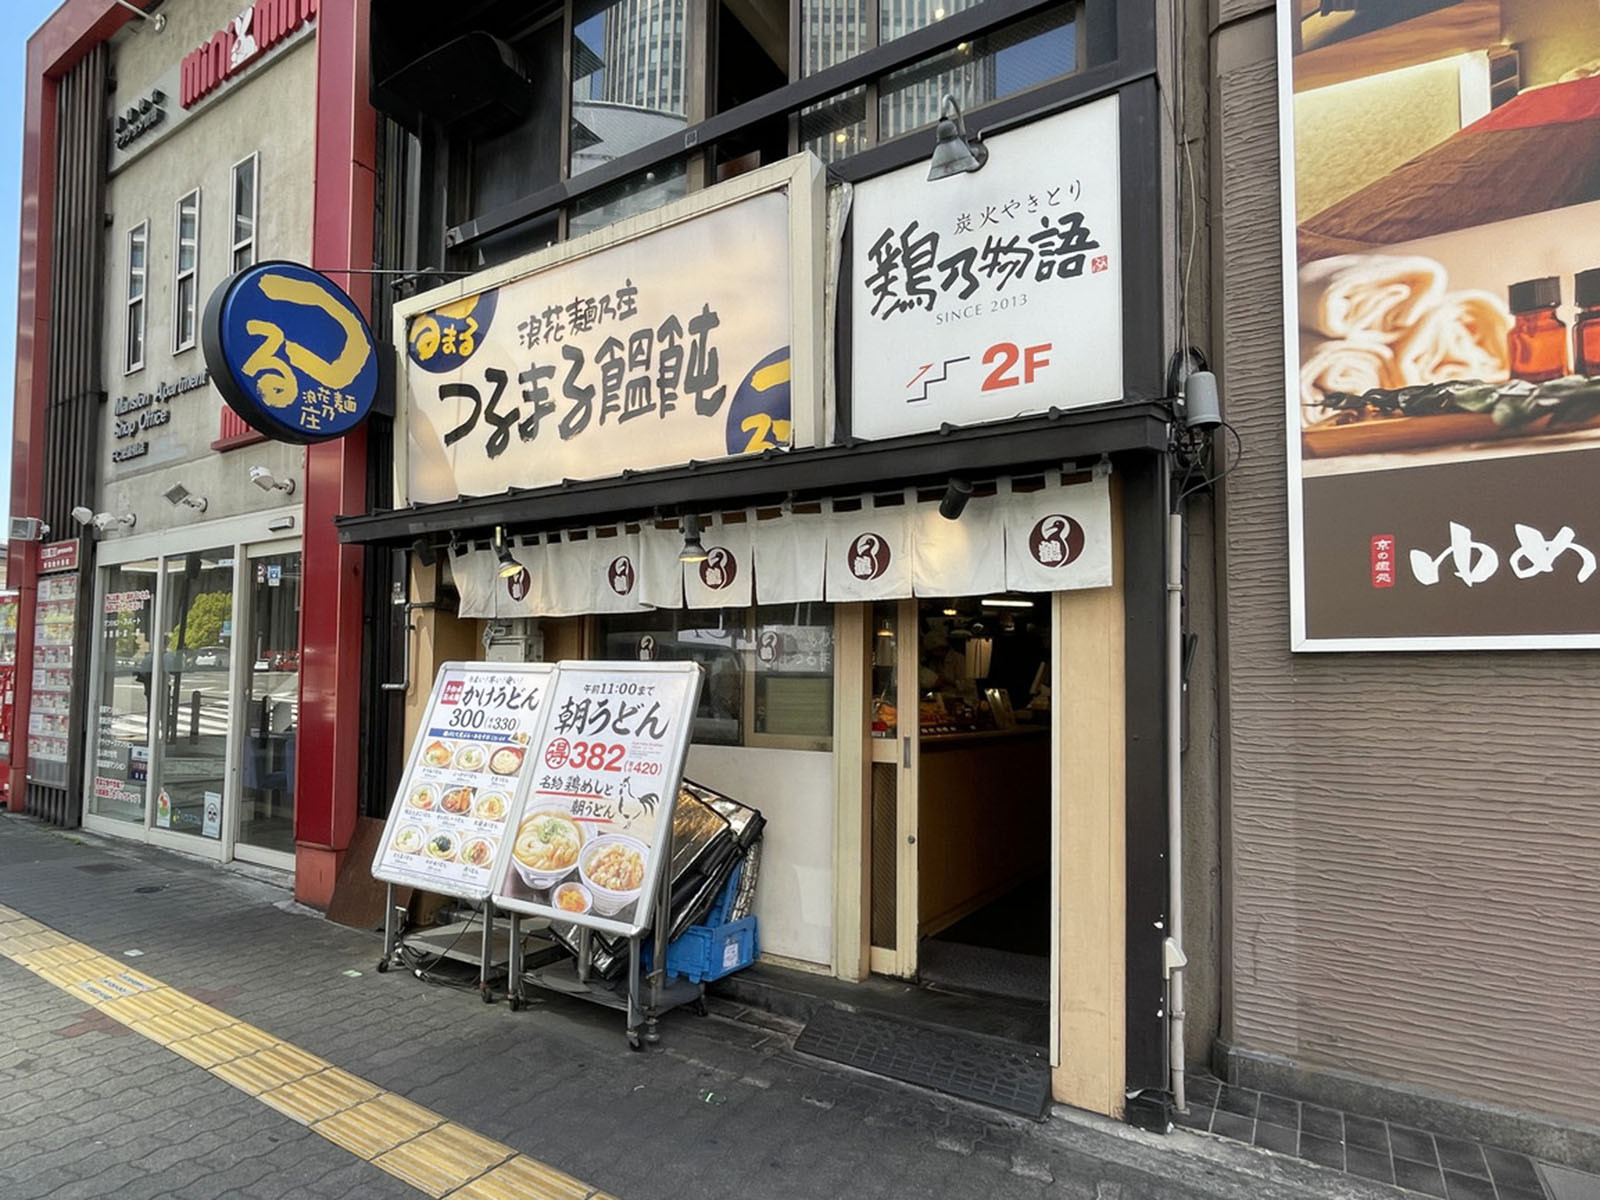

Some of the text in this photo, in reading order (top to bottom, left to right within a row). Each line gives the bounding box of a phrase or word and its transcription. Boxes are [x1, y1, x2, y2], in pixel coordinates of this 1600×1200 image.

[181, 21, 235, 109] mini
[953, 179, 1082, 236] 炭火やきとり
[865, 212, 1101, 320] 鶏乃物語
[936, 294, 1028, 325] SINCE 2013
[439, 303, 727, 460] つるまる饂飩
[981, 342, 1052, 392] 2F
[1410, 521, 1597, 587] ゆめ
[462, 685, 540, 711] かけうどん
[584, 683, 655, 696] 午前11:00まで
[449, 708, 485, 729] 300
[554, 696, 671, 740] 朝うどん
[569, 741, 625, 772] 382
[570, 799, 615, 820] 朝うどん
